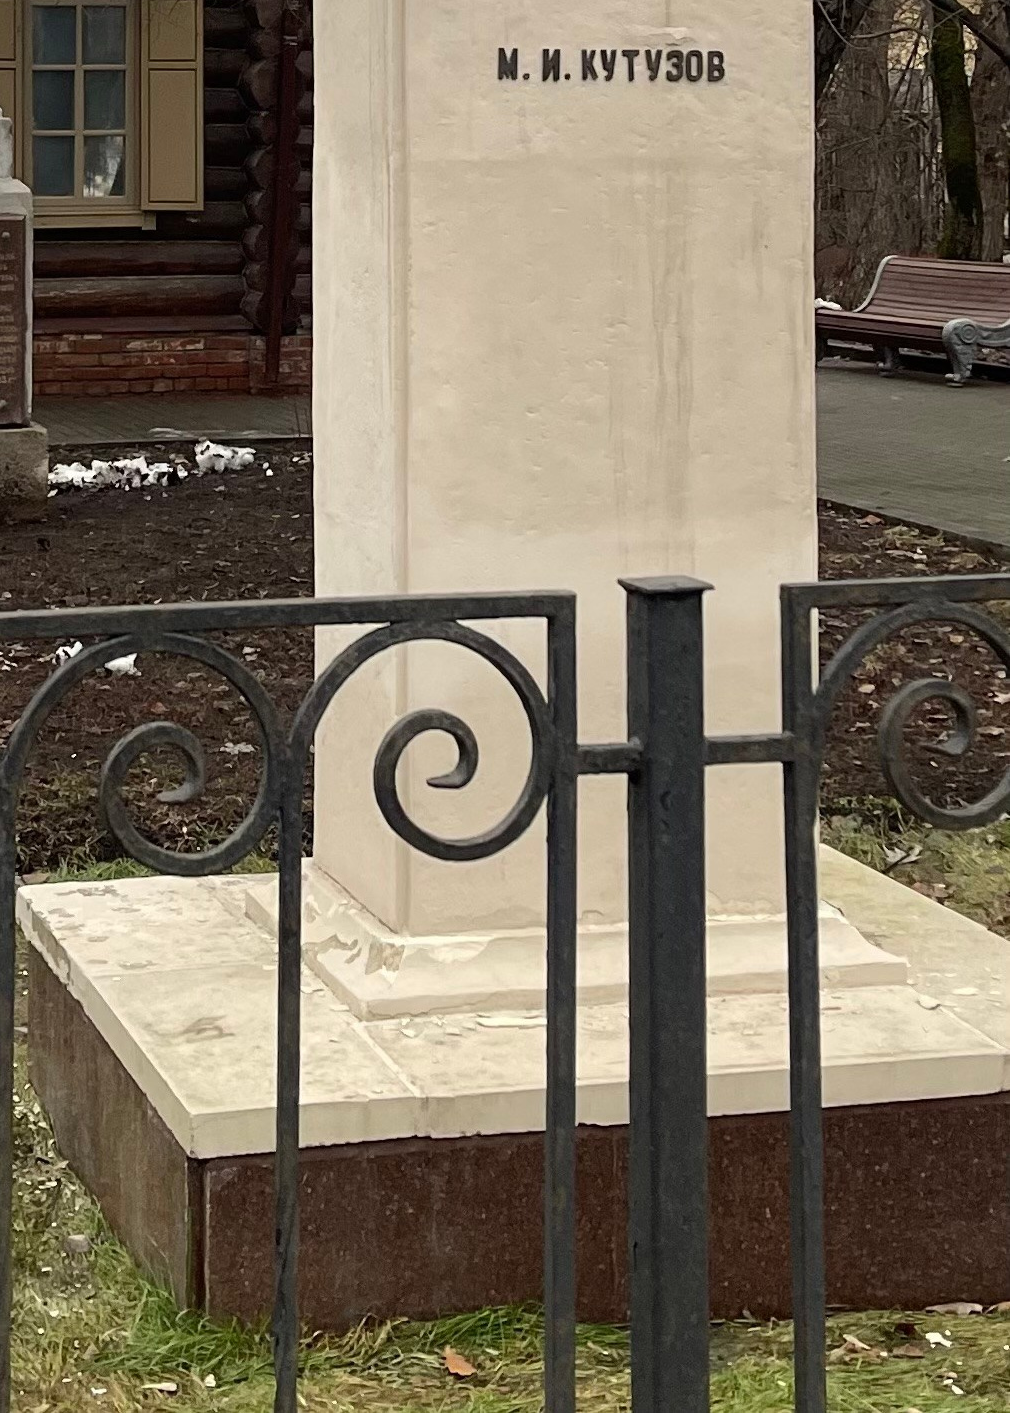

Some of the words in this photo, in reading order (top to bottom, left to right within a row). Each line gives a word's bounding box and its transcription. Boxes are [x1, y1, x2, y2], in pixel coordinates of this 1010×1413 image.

[498, 48, 530, 82] М.
[542, 49, 571, 82] И.
[581, 49, 725, 82] КУТУЗОВ
